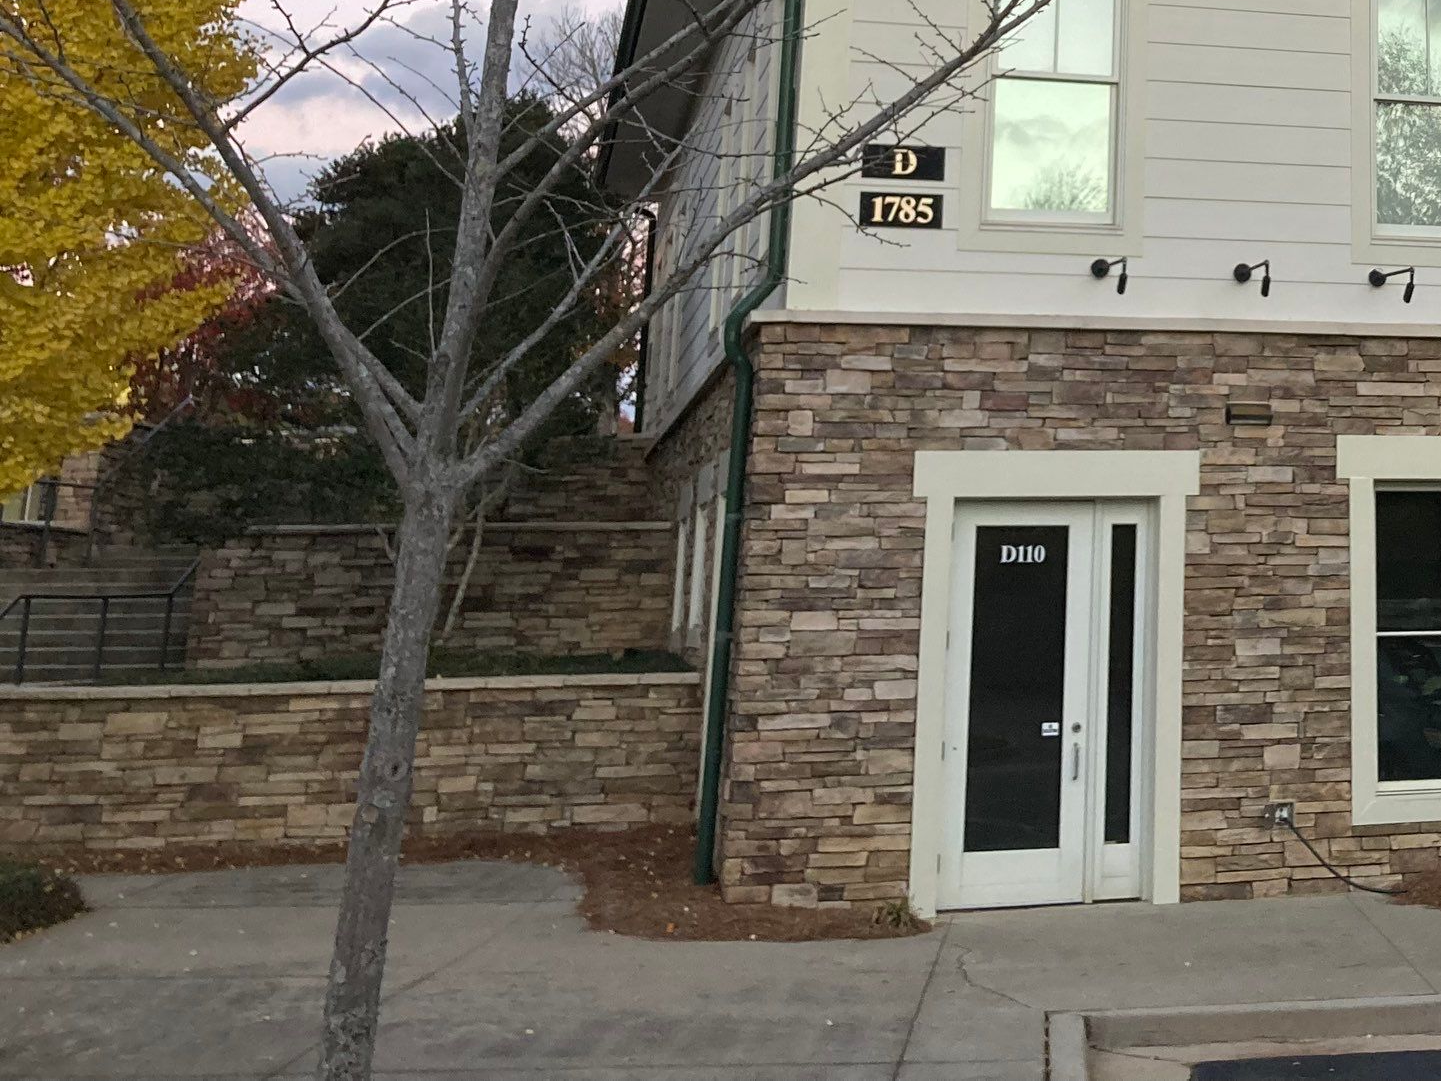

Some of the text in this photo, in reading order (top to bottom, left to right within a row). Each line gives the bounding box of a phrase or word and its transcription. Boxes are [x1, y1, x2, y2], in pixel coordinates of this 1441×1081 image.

[892, 148, 917, 175] D
[871, 196, 934, 224] 1785
[1000, 544, 1046, 564] D110
